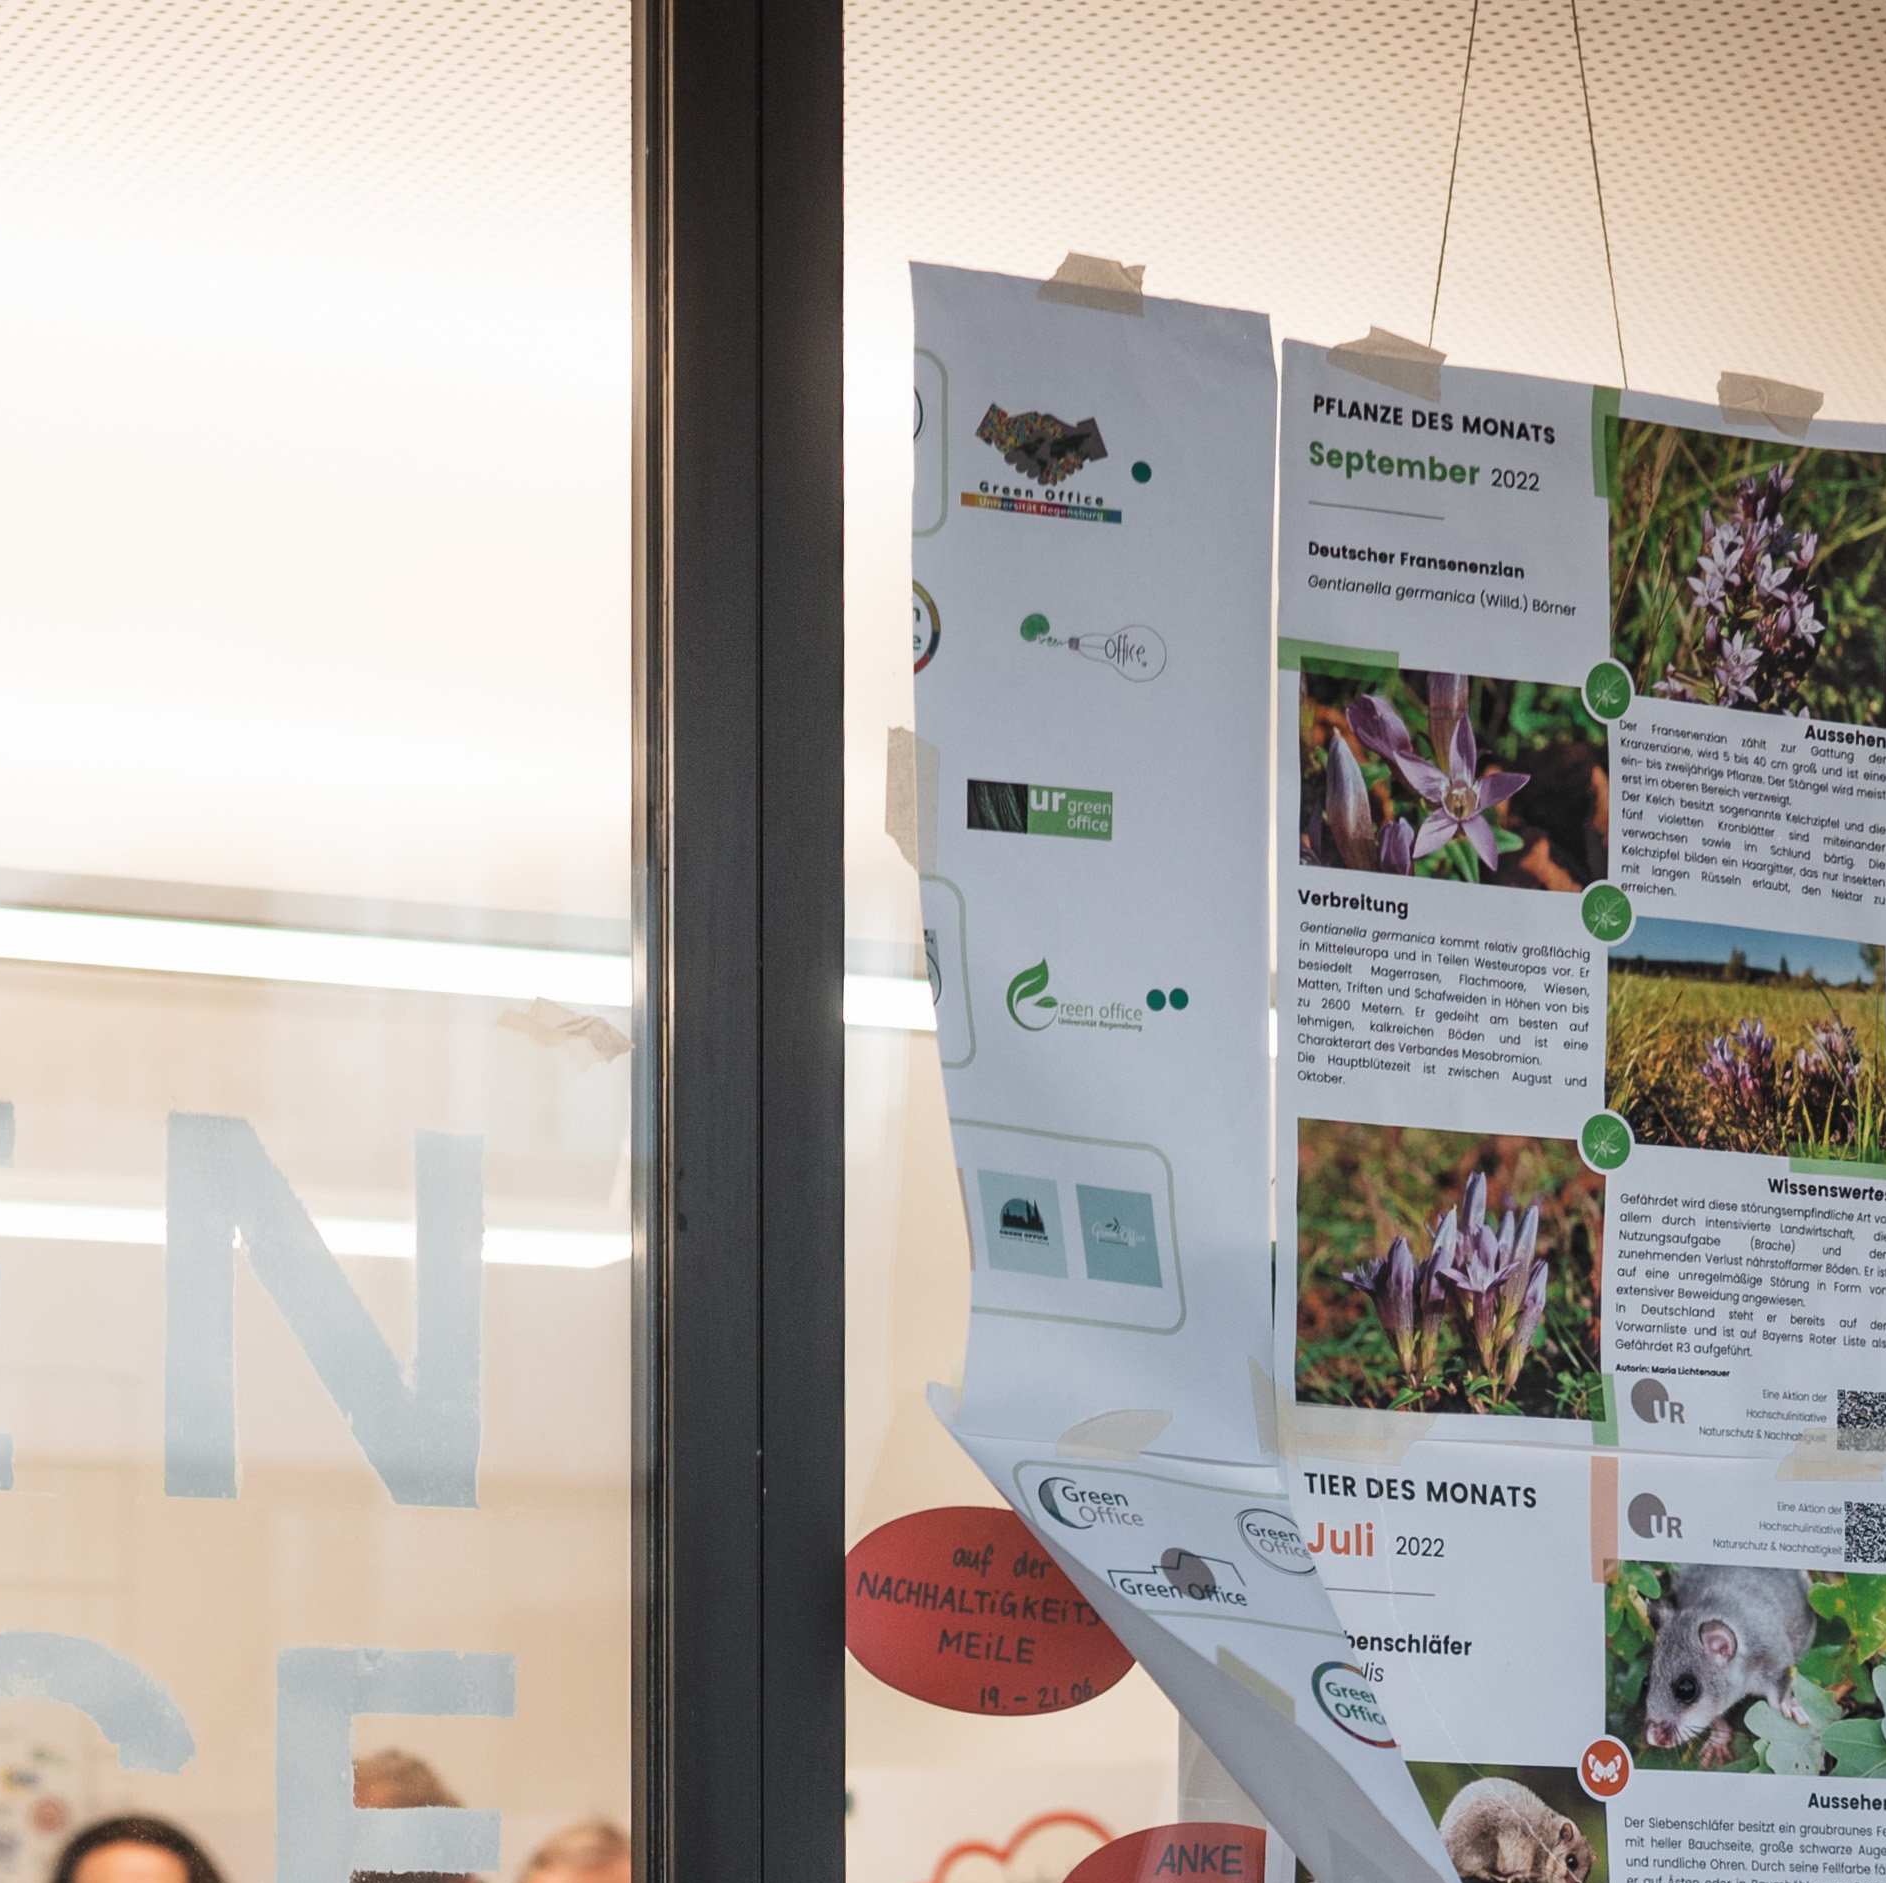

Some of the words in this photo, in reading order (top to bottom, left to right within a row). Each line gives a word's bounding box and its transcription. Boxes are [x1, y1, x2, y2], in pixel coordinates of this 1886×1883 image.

[1313, 394, 1403, 426] PFLANZE
[1411, 410, 1454, 432] DES
[1462, 415, 1555, 445] MONATS
[1309, 440, 1480, 485] September
[1491, 468, 1540, 492] 2022
[979, 481, 1034, 499] Green
[1045, 490, 1104, 507] Office
[1309, 541, 1396, 565] Deutscher
[1400, 552, 1525, 579] Fransenenzian
[1308, 574, 1392, 596] Gentianella
[1395, 586, 1476, 605] germanica
[1480, 589, 1528, 613] (Willd.)
[1532, 598, 1576, 616] Börner
[1805, 724, 1886, 749] Aussehen
[1030, 789, 1066, 813] ur
[1068, 800, 1111, 817] green
[1067, 815, 1109, 833] office
[1297, 889, 1408, 920] Verbreitung
[1300, 921, 1368, 938] Gentianella
[1371, 930, 1436, 945] germanica
[1440, 934, 1480, 950] kommt
[1484, 940, 1518, 954] relativ
[1521, 945, 1591, 964] großflächig
[1099, 1002, 1143, 1022] office
[1620, 1193, 1678, 1208] Gefährdet
[1681, 1197, 1705, 1209] wird
[1708, 1199, 1738, 1212] diese
[1741, 1202, 1855, 1222] störungsempfindliche
[1856, 1212, 1871, 1224] Art
[1615, 1364, 1650, 1373] Autorin:
[1651, 1366, 1677, 1375] Maria
[1678, 1366, 1730, 1377] Lichtenauer
[1763, 1389, 1780, 1400] Eine
[1781, 1391, 1810, 1402] Aktion
[1811, 1392, 1828, 1403] der
[1746, 1408, 1827, 1423] Hochschulinitiative
[1699, 1426, 1755, 1439] Naturschutz
[1755, 1429, 1762, 1439] &
[1061, 1485, 1129, 1507] Green
[1303, 1472, 1357, 1498] TIER
[1366, 1478, 1416, 1501] DES
[1426, 1480, 1537, 1509] MONATS
[1079, 1506, 1145, 1527] Office
[1777, 1502, 1796, 1512] Eine
[1798, 1503, 1826, 1514] Aktion
[1827, 1505, 1843, 1516] der
[1246, 1522, 1301, 1543] Green
[1307, 1521, 1374, 1556] Juli
[1395, 1536, 1445, 1558] 2022
[1759, 1521, 1843, 1536] Hochschulinitiative
[1713, 1538, 1768, 1551] Naturschutz
[1770, 1541, 1777, 1551] &
[1779, 1542, 1843, 1557] Nachhaltigkeit
[952, 1544, 994, 1578] auf
[1013, 1552, 1053, 1579] der
[1119, 1578, 1183, 1599] Green
[1188, 1583, 1248, 1606] Office
[1624, 1816, 1645, 1829] Der
[1648, 1817, 1735, 1832] Siebenschläfer
[1738, 1820, 1775, 1833] besitzt
[1778, 1822, 1796, 1834] ein
[1799, 1824, 1873, 1838] graubraunes
[1155, 1844, 1243, 1876] ANKE
